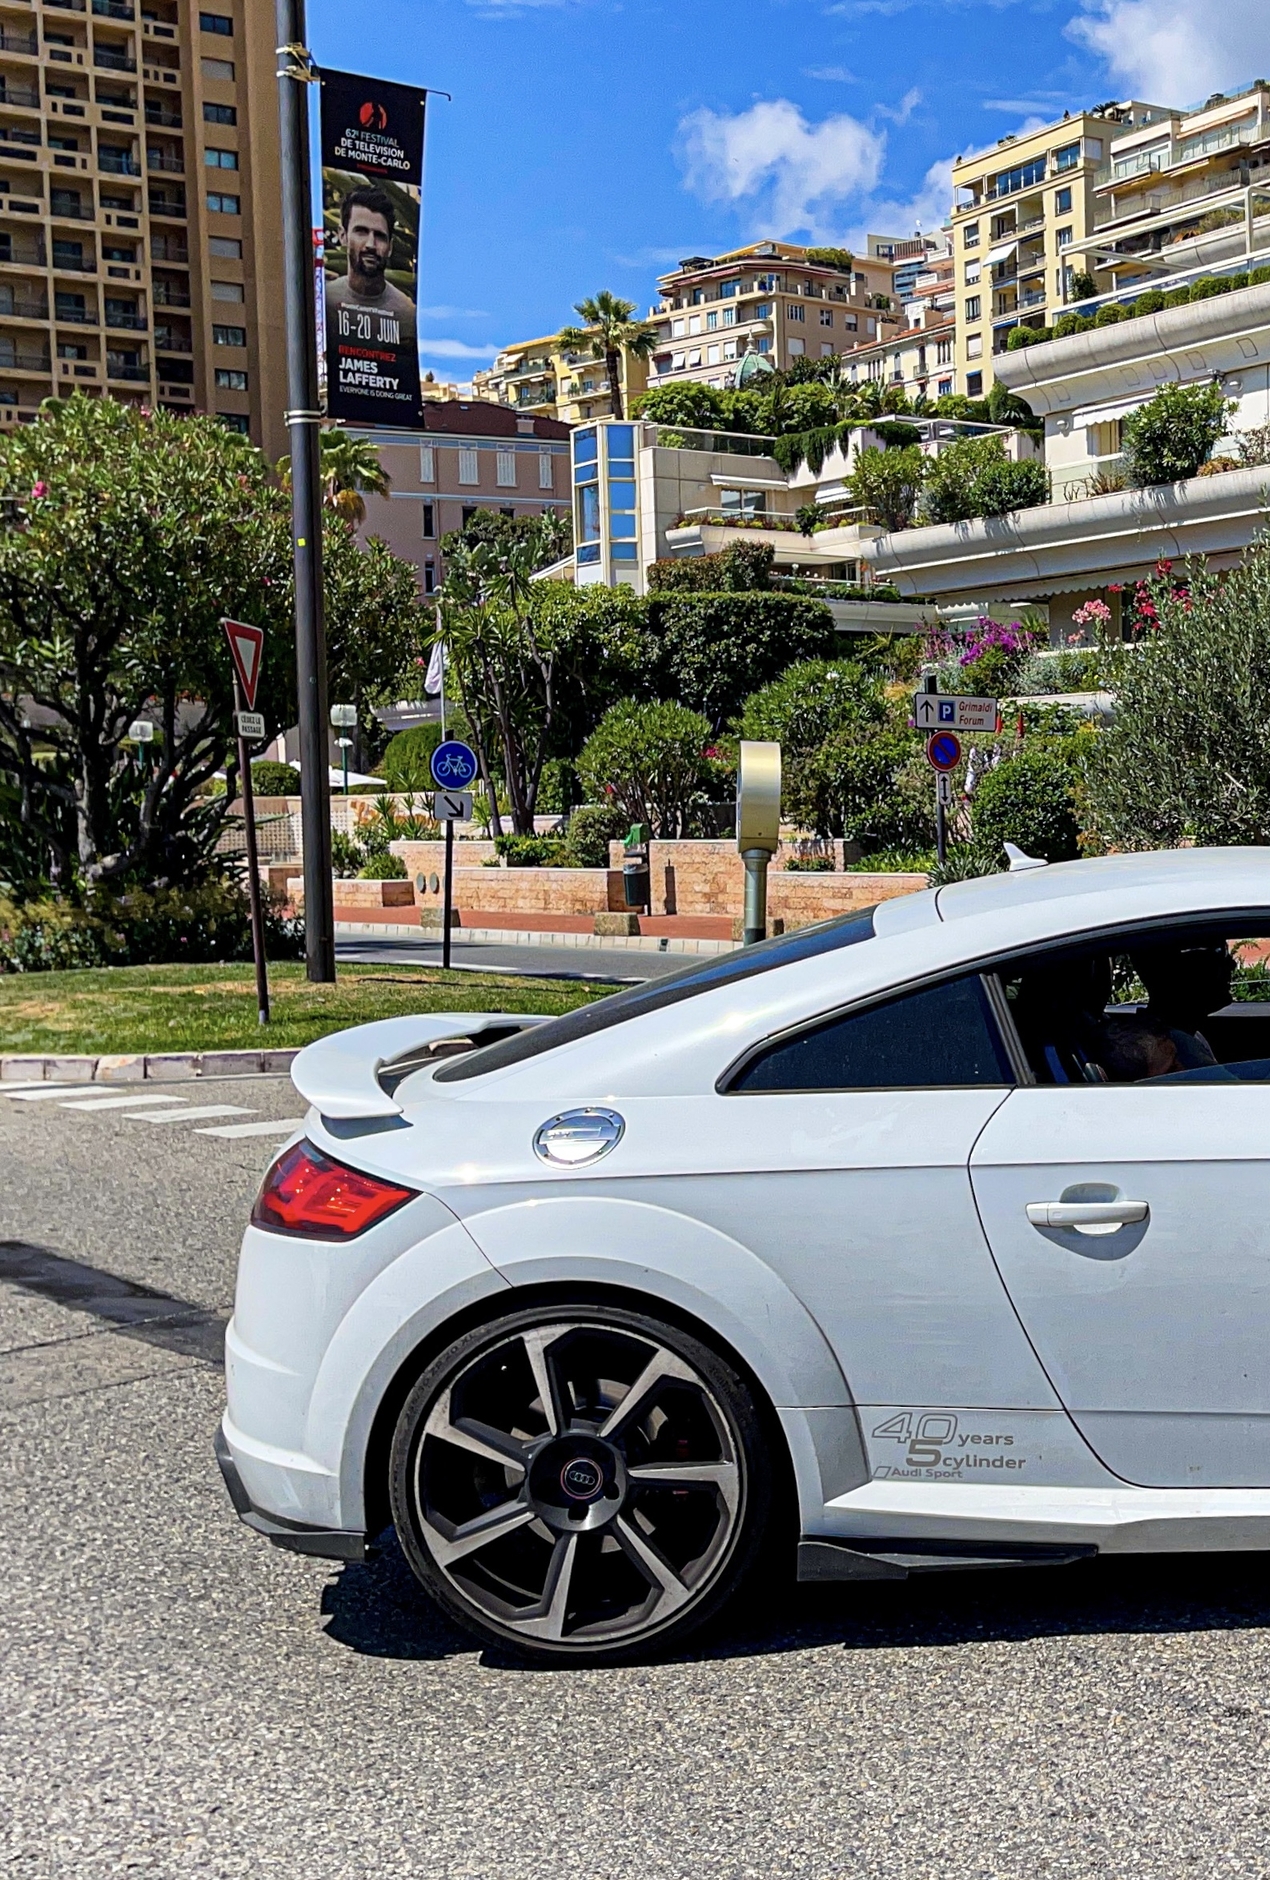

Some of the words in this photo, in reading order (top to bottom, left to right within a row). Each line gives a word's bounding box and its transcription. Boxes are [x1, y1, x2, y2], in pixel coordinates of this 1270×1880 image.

[340, 137, 353, 148] DE
[355, 140, 404, 159] TELEVISION
[360, 131, 400, 148] FESTIVAL
[334, 146, 346, 157] DE
[347, 150, 411, 170] MONTE-CARLO
[337, 310, 371, 340] 16-20
[377, 318, 400, 345] JUIN
[338, 345, 397, 362] RENCONTREZ
[339, 357, 378, 374] JAMES
[339, 371, 399, 390] LAFFERTY
[339, 385, 370, 397] EVERYONE
[376, 390, 395, 399] DOING
[395, 392, 413, 402] GREAT
[958, 701, 993, 713] Grimaldi
[958, 715, 985, 726] Forum
[872, 1412, 958, 1444] 40
[957, 1433, 1014, 1447] years
[906, 1438, 943, 1468] 5
[942, 1454, 1027, 1470] cylinder
[891, 1467, 922, 1477] Audi
[926, 1469, 963, 1479] Sport
